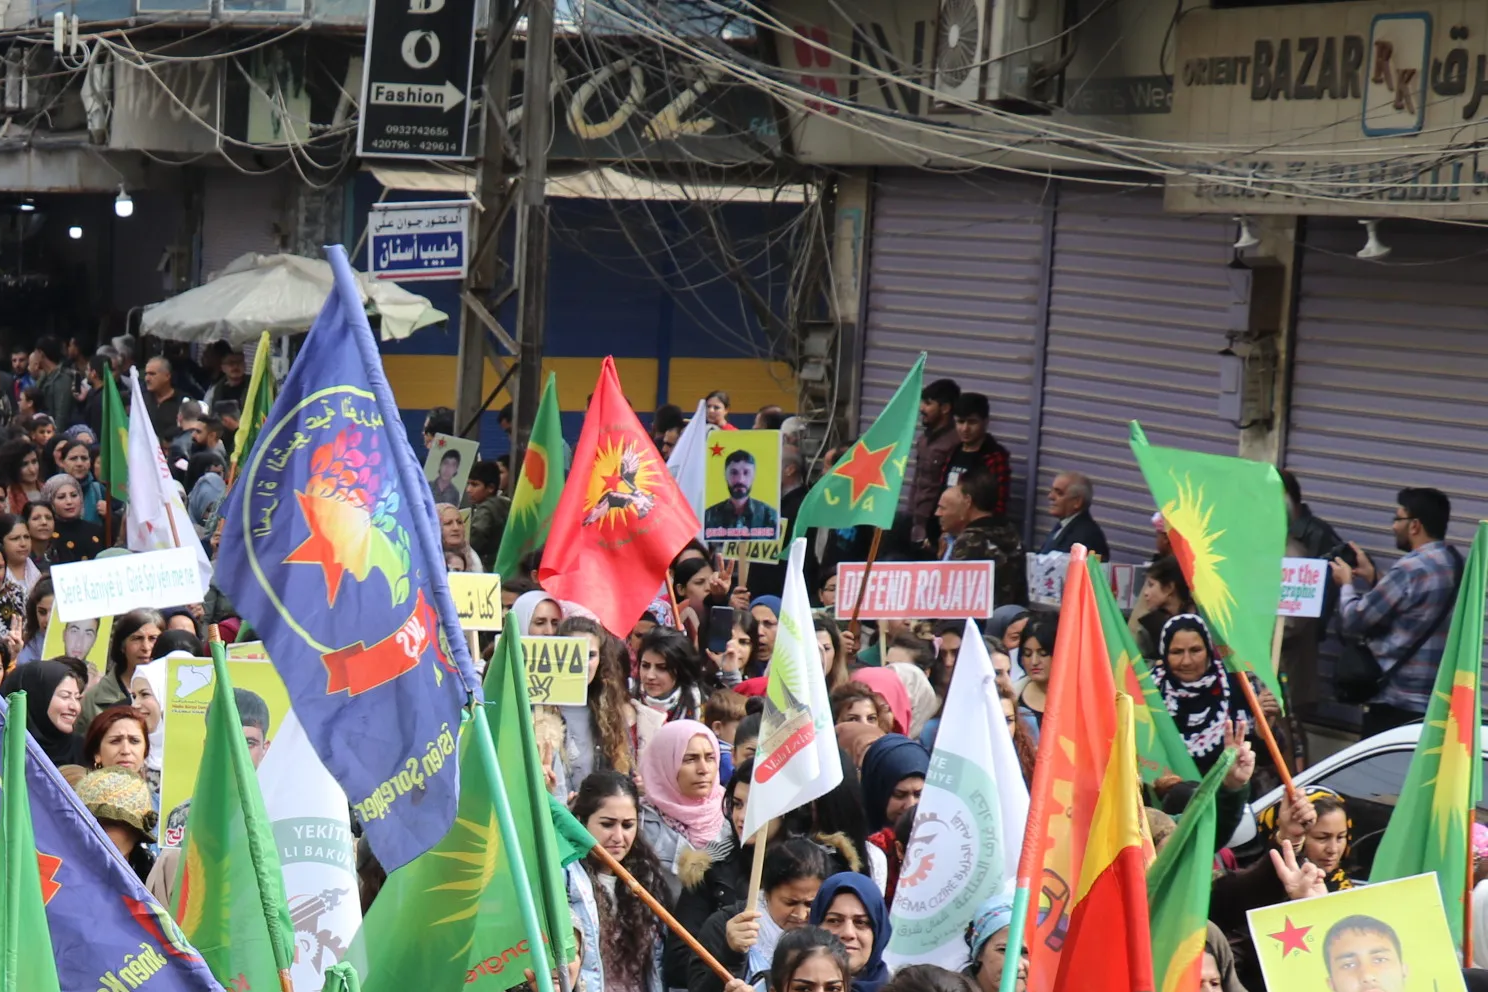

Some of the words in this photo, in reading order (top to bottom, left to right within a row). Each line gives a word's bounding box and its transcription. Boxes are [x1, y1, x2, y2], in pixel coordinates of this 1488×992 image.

[1182, 56, 1251, 86] ORIENT
[1251, 36, 1363, 101] BAZAR
[375, 85, 444, 104] Fashion
[371, 139, 410, 149] 420796
[419, 141, 457, 151] 429614
[396, 218, 423, 230] جوان
[379, 234, 418, 269] أسنان
[419, 235, 459, 266] طبيب
[1298, 564, 1320, 585] the
[477, 580, 499, 619] كلنا
[913, 569, 988, 611] ROJAVA
[284, 846, 298, 858] LI
